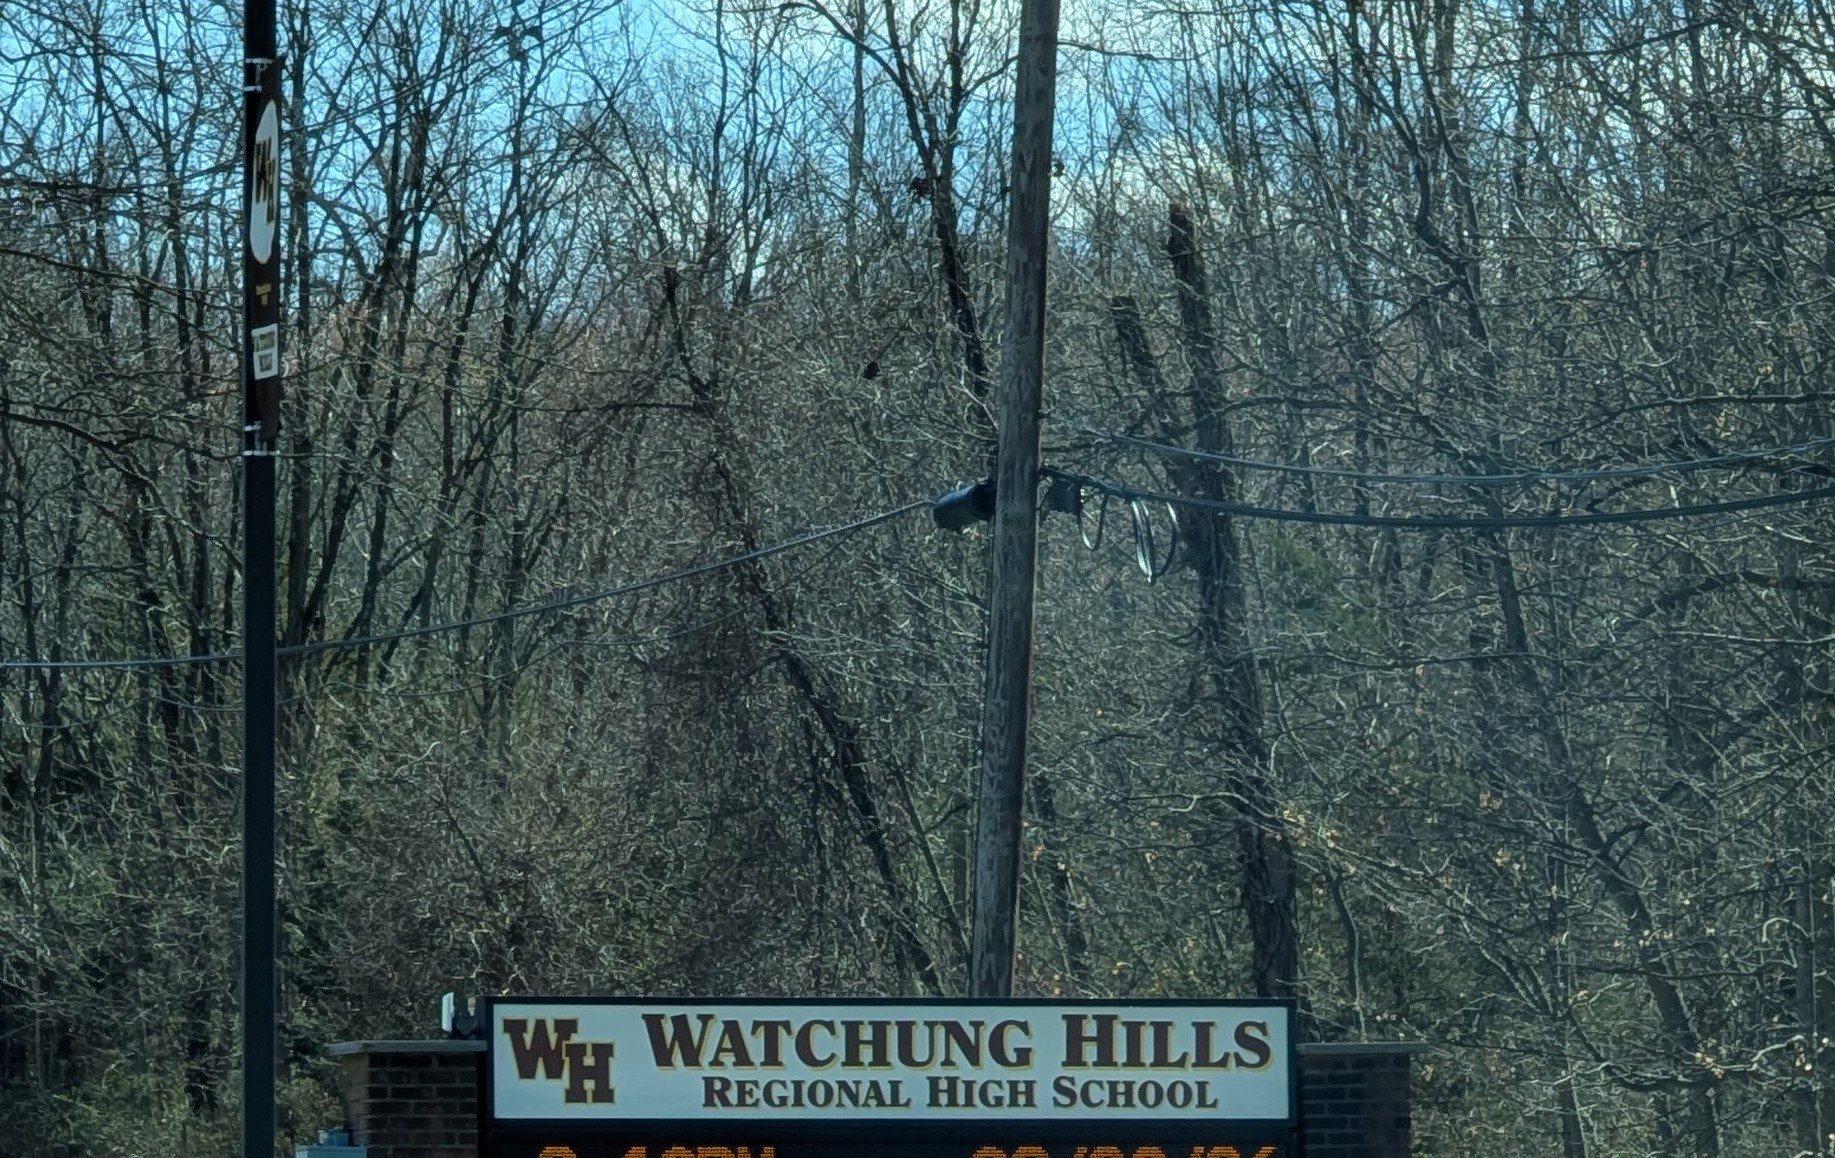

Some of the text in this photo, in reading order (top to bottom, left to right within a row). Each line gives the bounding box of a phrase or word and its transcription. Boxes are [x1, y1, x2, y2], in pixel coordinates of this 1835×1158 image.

[502, 1017, 616, 1105] WH
[640, 1012, 1273, 1070] WATCHUNG HILLS
[701, 1075, 1219, 1110] REGIONAL HIGH SCHOOL
